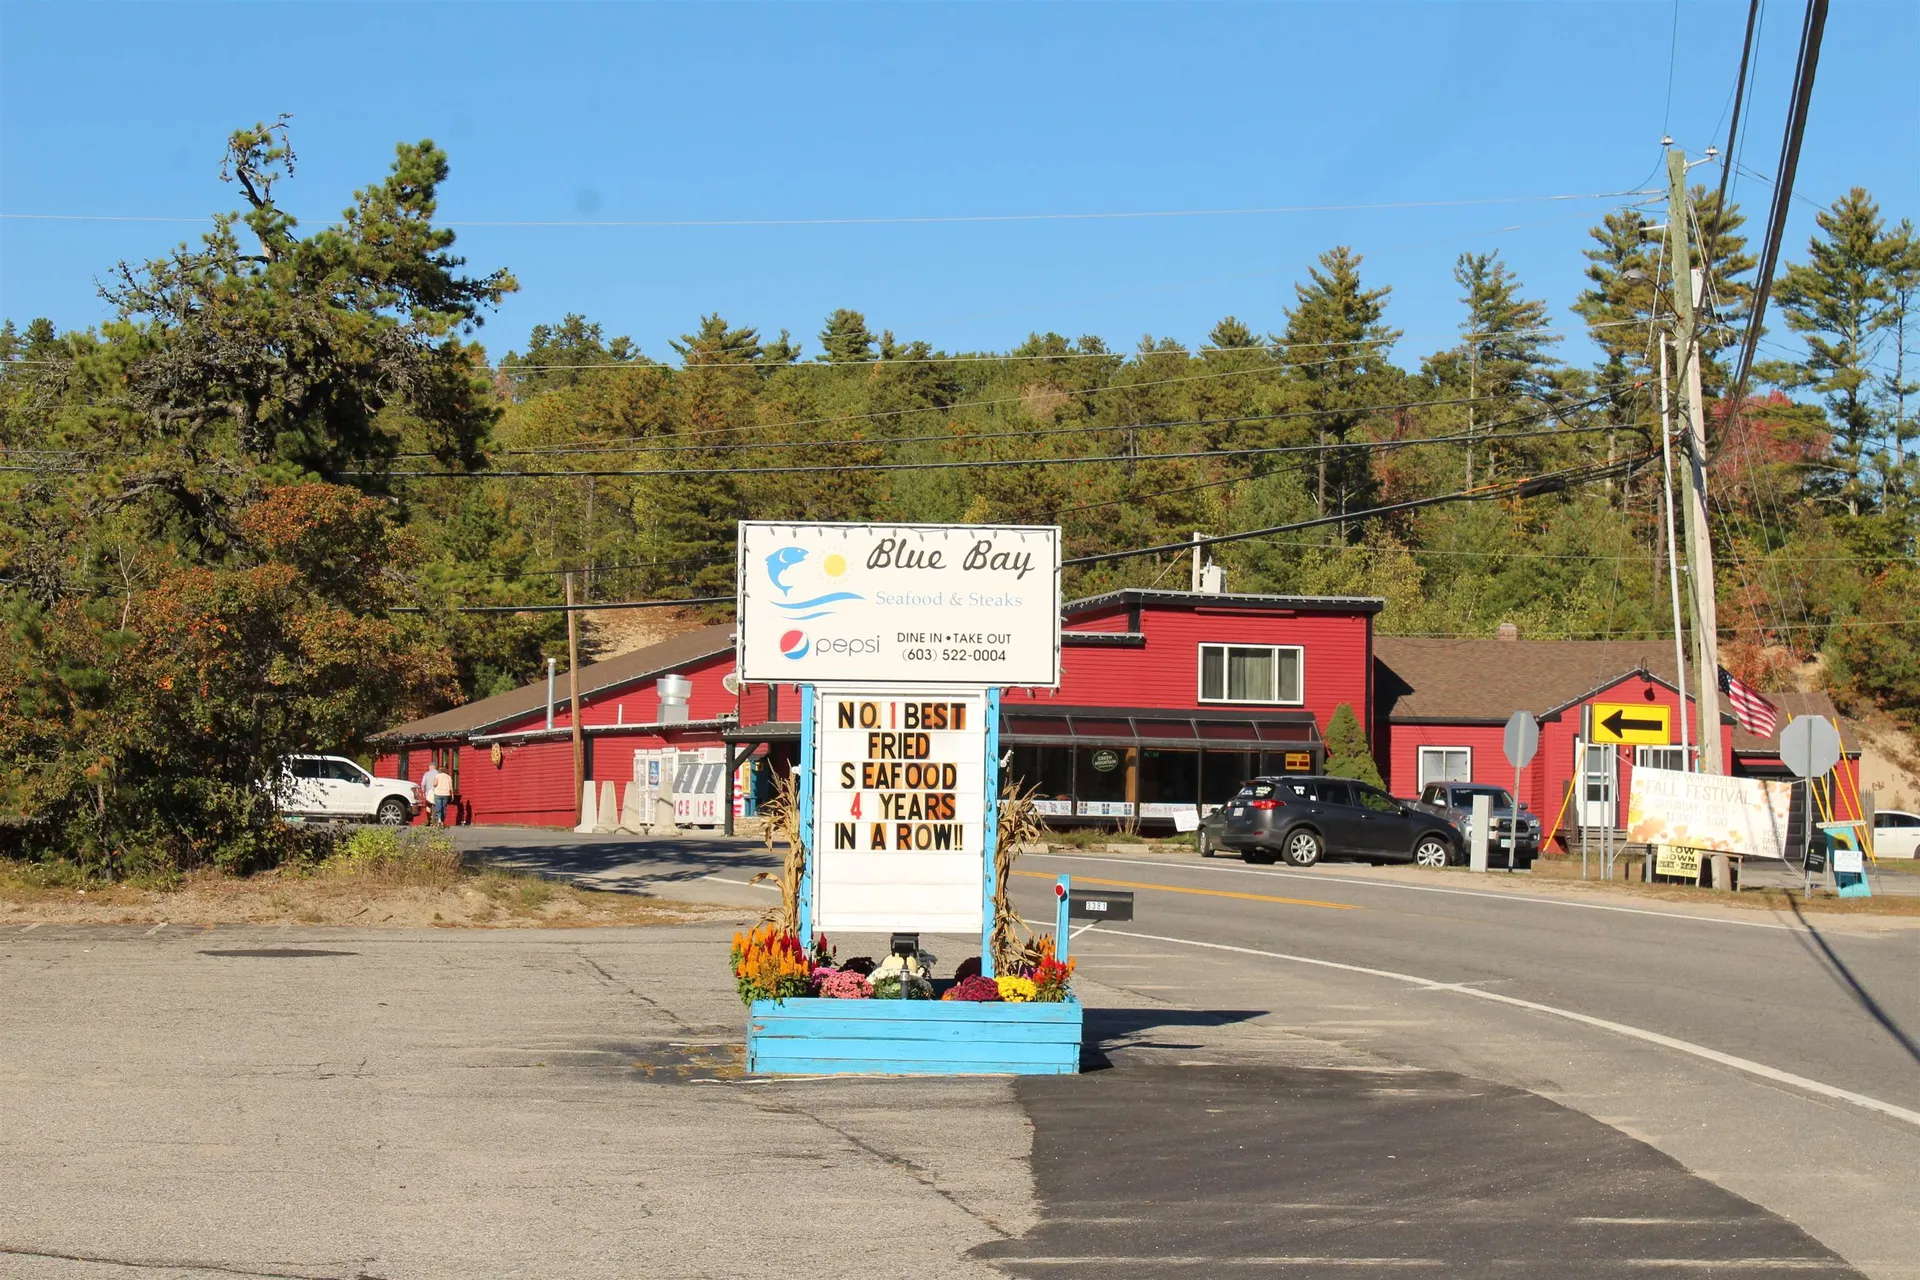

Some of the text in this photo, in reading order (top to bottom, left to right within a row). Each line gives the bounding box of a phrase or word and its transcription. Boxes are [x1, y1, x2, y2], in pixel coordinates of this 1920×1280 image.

[866, 538, 1035, 580] Blue Bay
[876, 591, 1023, 608] Seafood & Steaks
[816, 635, 880, 657] pepsi
[897, 632, 1011, 645] DINE IN TAKE OUT
[902, 649, 1006, 663] (603) 522-0004
[838, 702, 967, 730] NO. 1 BEST
[868, 732, 931, 760] FRIED
[840, 762, 957, 790] SEAFOOD
[1684, 773, 1736, 788] WAKEFIELD
[1646, 779, 1753, 805] FALL FESTIVAL
[697, 800, 714, 818] ICE
[850, 792, 956, 820] 4 YEARS
[834, 823, 963, 851] IN A ROW!!
